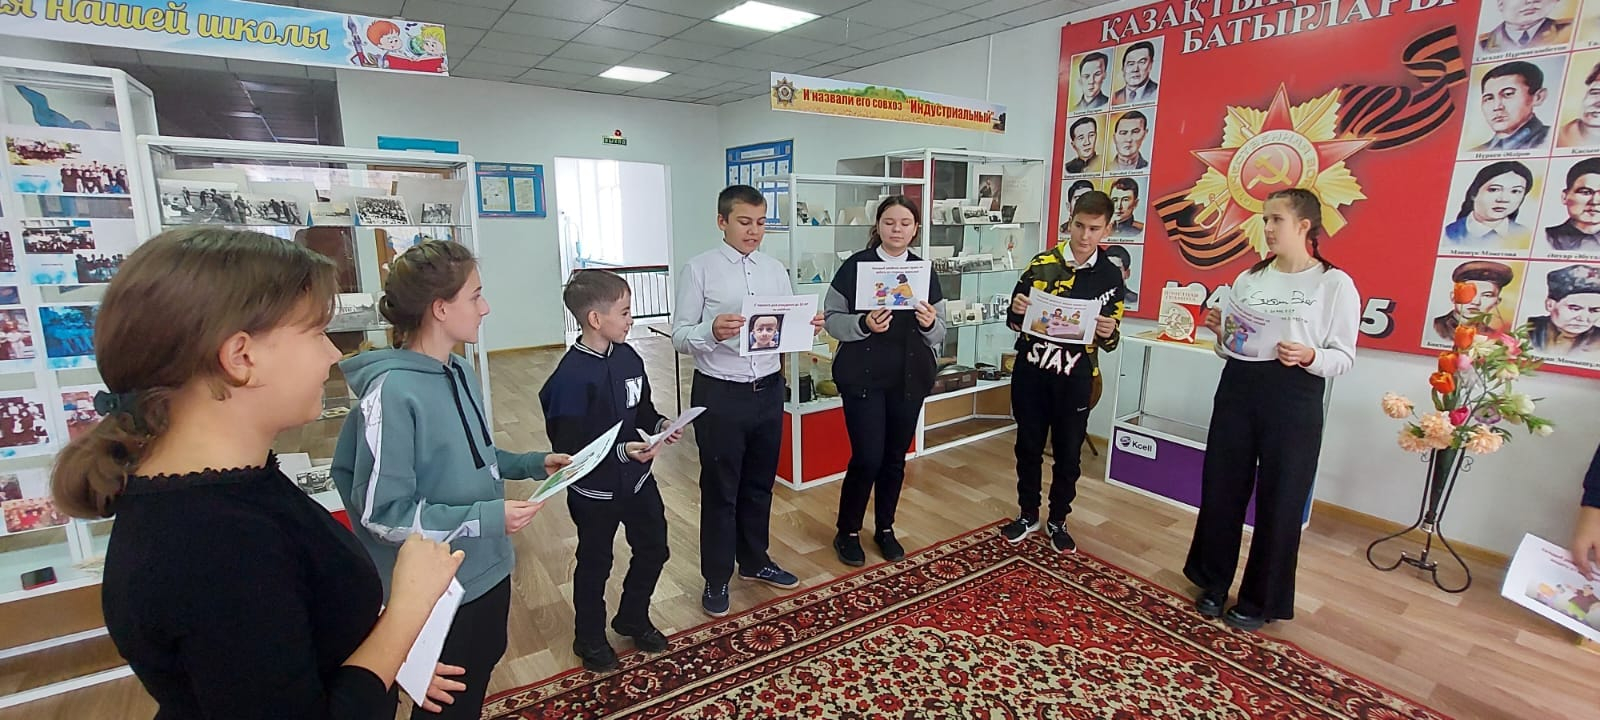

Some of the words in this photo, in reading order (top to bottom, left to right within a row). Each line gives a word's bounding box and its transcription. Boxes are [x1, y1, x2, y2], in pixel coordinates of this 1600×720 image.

[45, 0, 190, 35] нашей
[197, 14, 330, 50] школы
[803, 89, 810, 100] И
[812, 91, 854, 106] назвали
[856, 96, 871, 107] его
[872, 98, 903, 111] совхоз
[1027, 341, 1082, 376] STAY
[625, 376, 643, 409] N
[1132, 440, 1153, 453] Kcell
